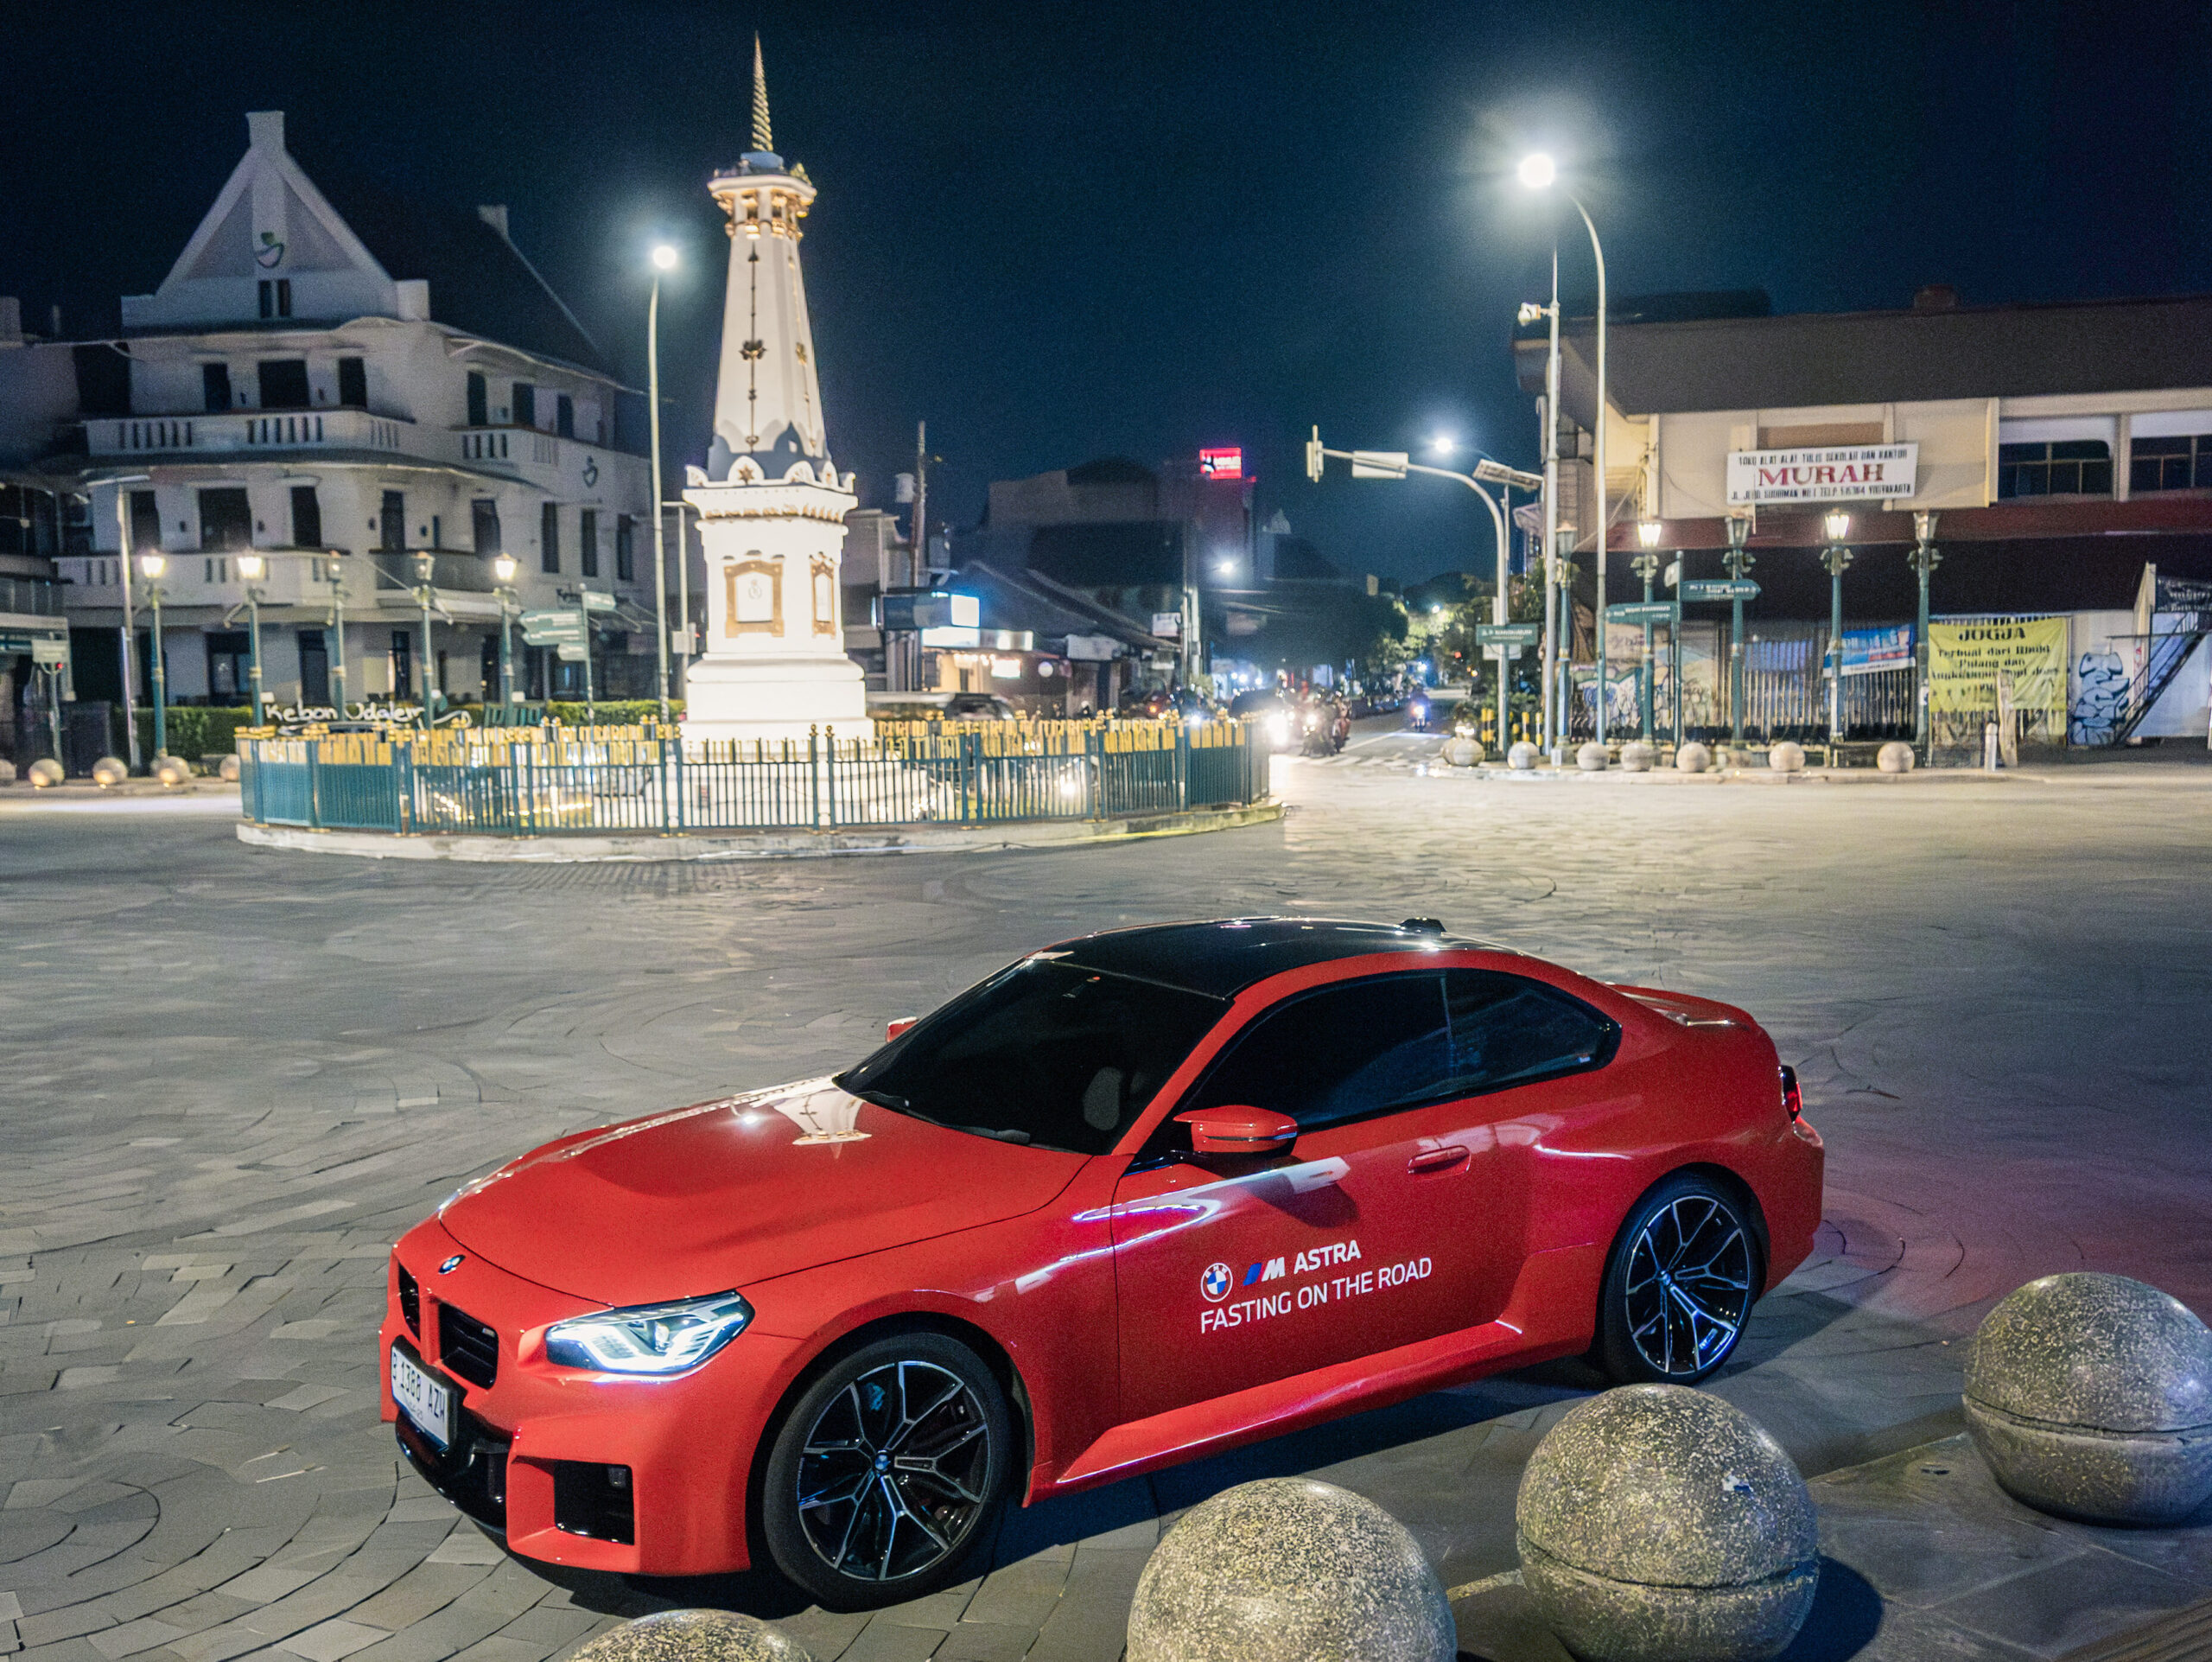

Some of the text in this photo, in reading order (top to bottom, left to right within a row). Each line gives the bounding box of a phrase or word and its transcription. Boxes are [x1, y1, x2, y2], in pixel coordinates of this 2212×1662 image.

[1758, 463, 1884, 486] MURAH
[1959, 627, 2025, 641] JOGJA
[264, 698, 338, 723] Kebon
[1294, 1239, 1362, 1275] ASTRA
[1200, 1257, 1433, 1334] FASTING ON THE ROAD
